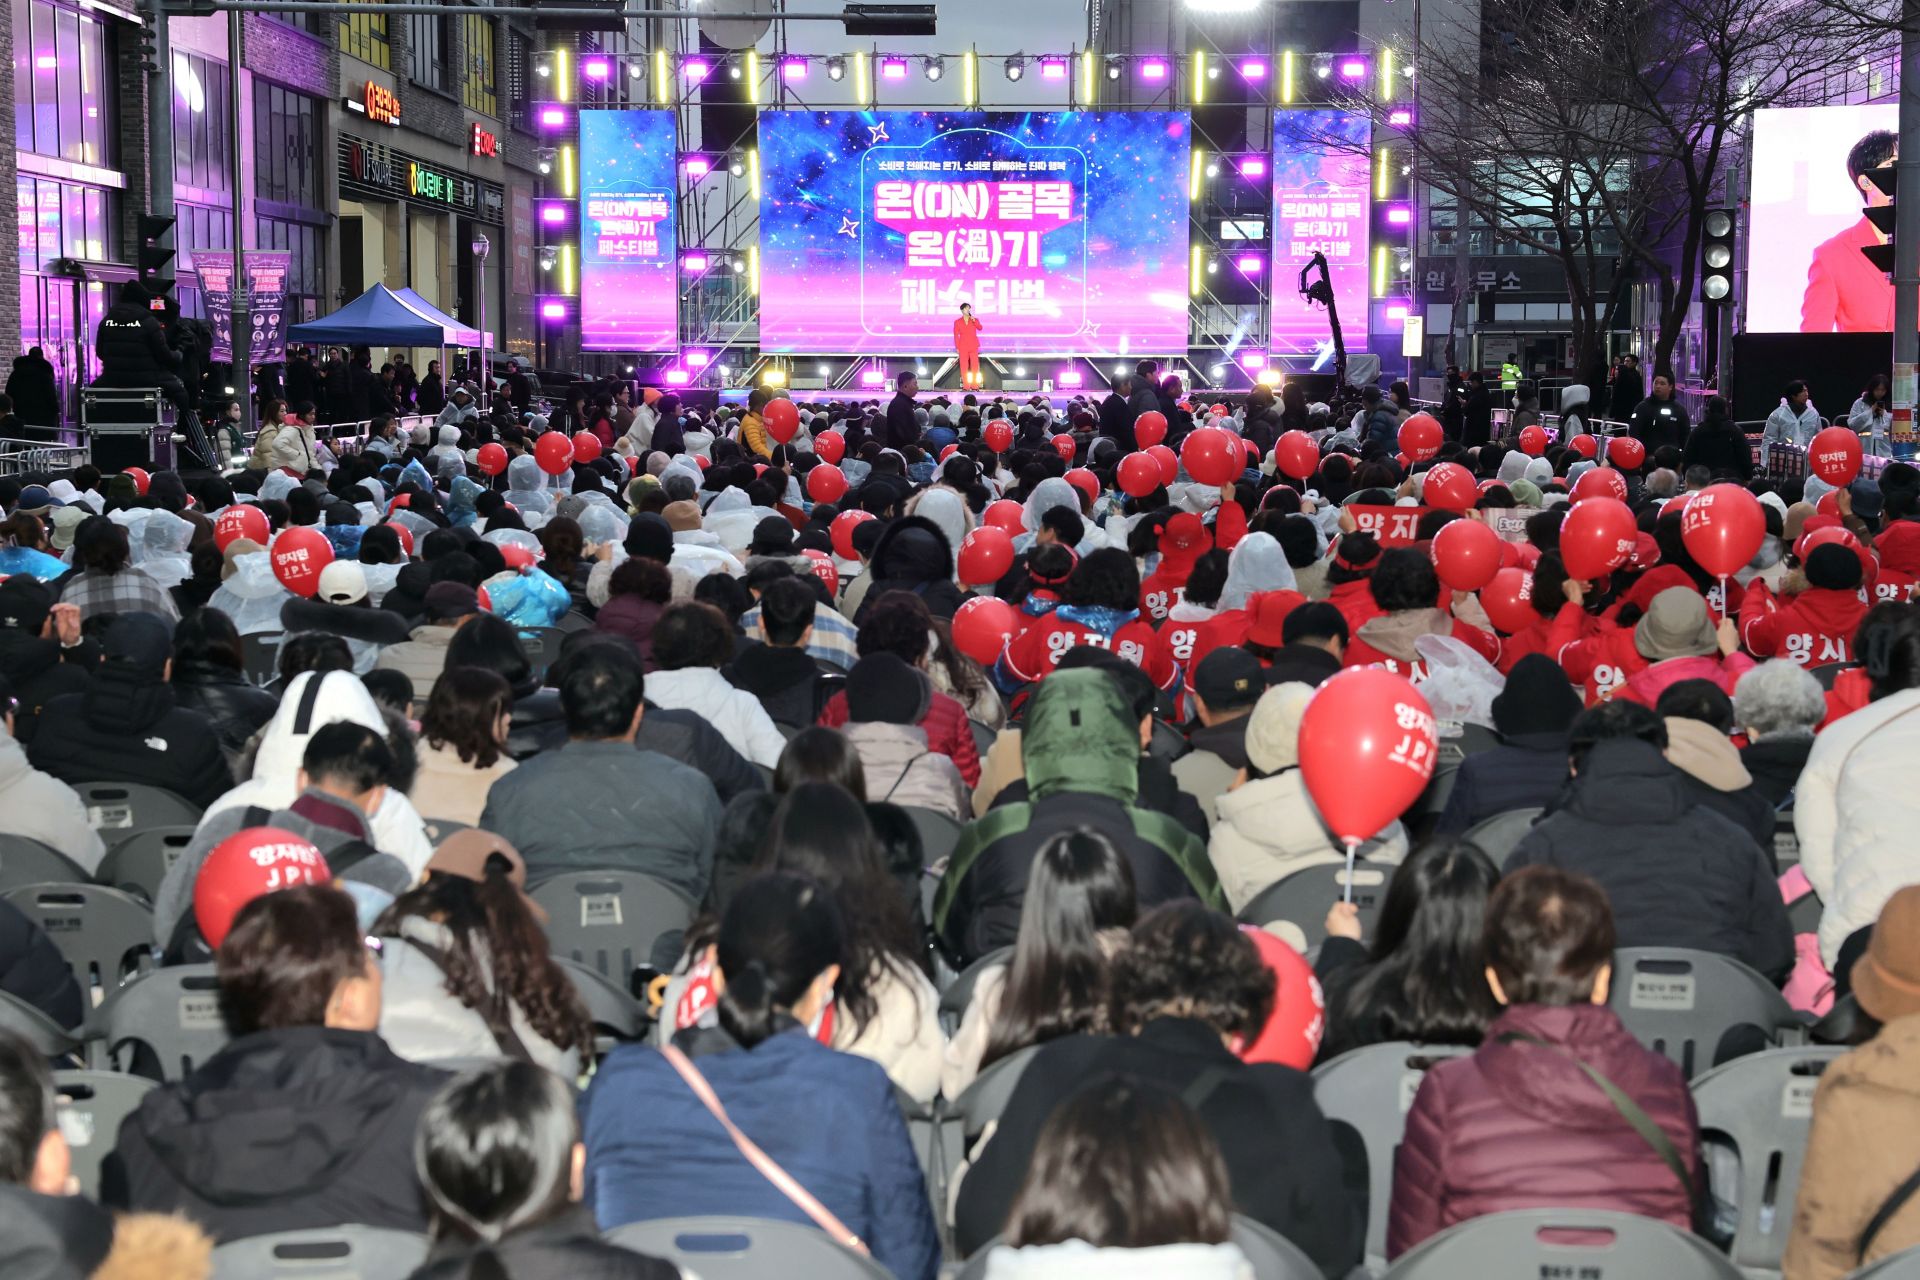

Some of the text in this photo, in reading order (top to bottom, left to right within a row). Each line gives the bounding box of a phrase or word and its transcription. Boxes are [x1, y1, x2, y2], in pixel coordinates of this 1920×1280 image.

[877, 182, 1070, 219] 온(ON) 골목
[908, 228, 1038, 268] 온(溫)기
[900, 279, 1046, 316] 페스티벌
[1818, 451, 1847, 464] 양지원
[278, 547, 310, 566] 양지원
